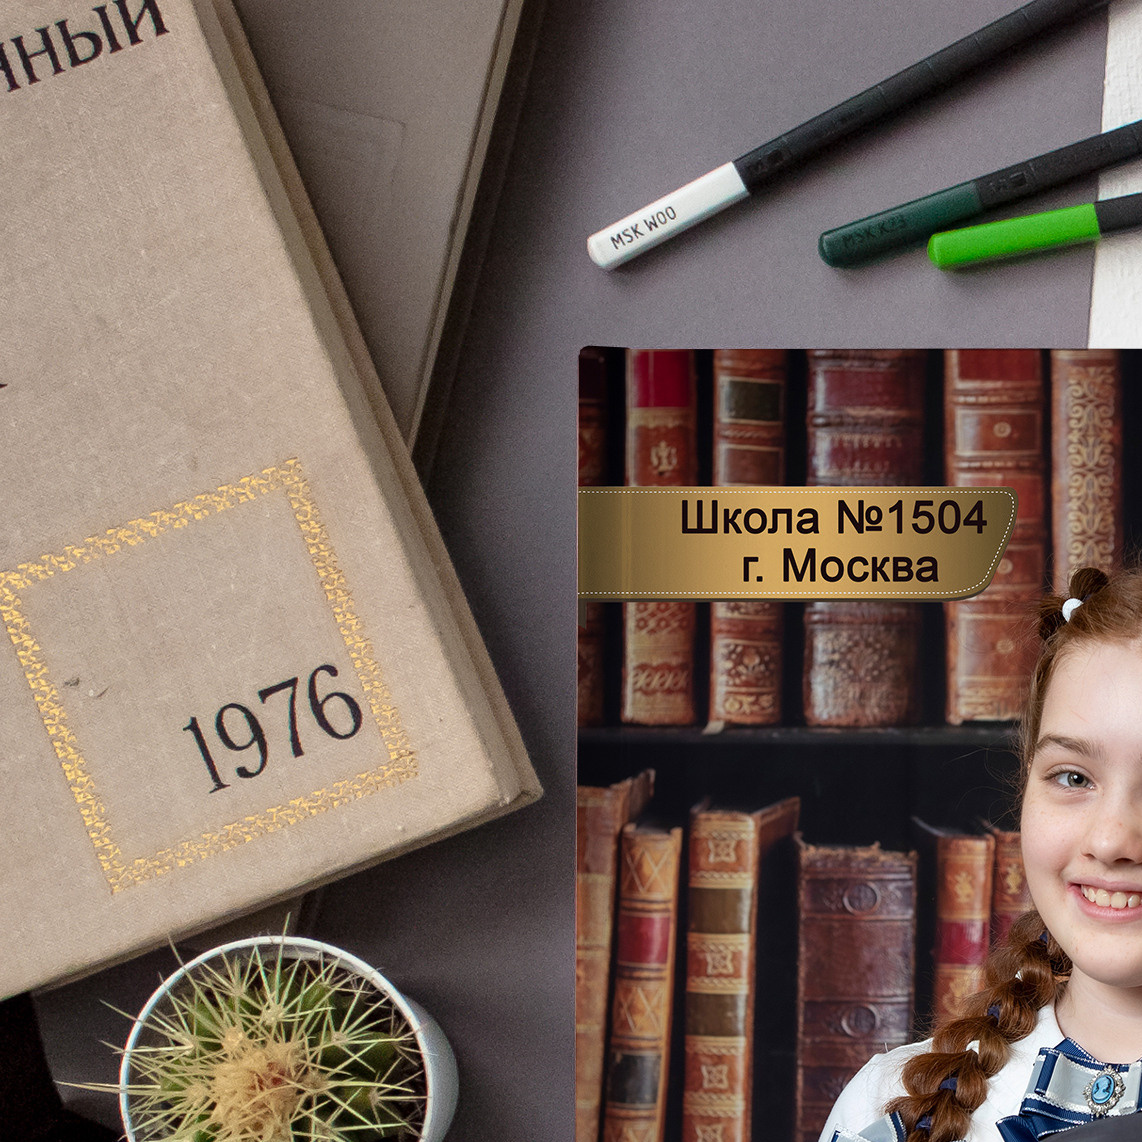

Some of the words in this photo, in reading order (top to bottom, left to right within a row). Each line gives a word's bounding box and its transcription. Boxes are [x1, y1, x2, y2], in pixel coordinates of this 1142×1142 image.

[610, 223, 645, 250] MSK
[680, 499, 820, 535] Школа
[837, 499, 988, 535] №1504
[742, 557, 764, 583] г.
[782, 548, 940, 583] Москва
[182, 664, 363, 794] 1976
